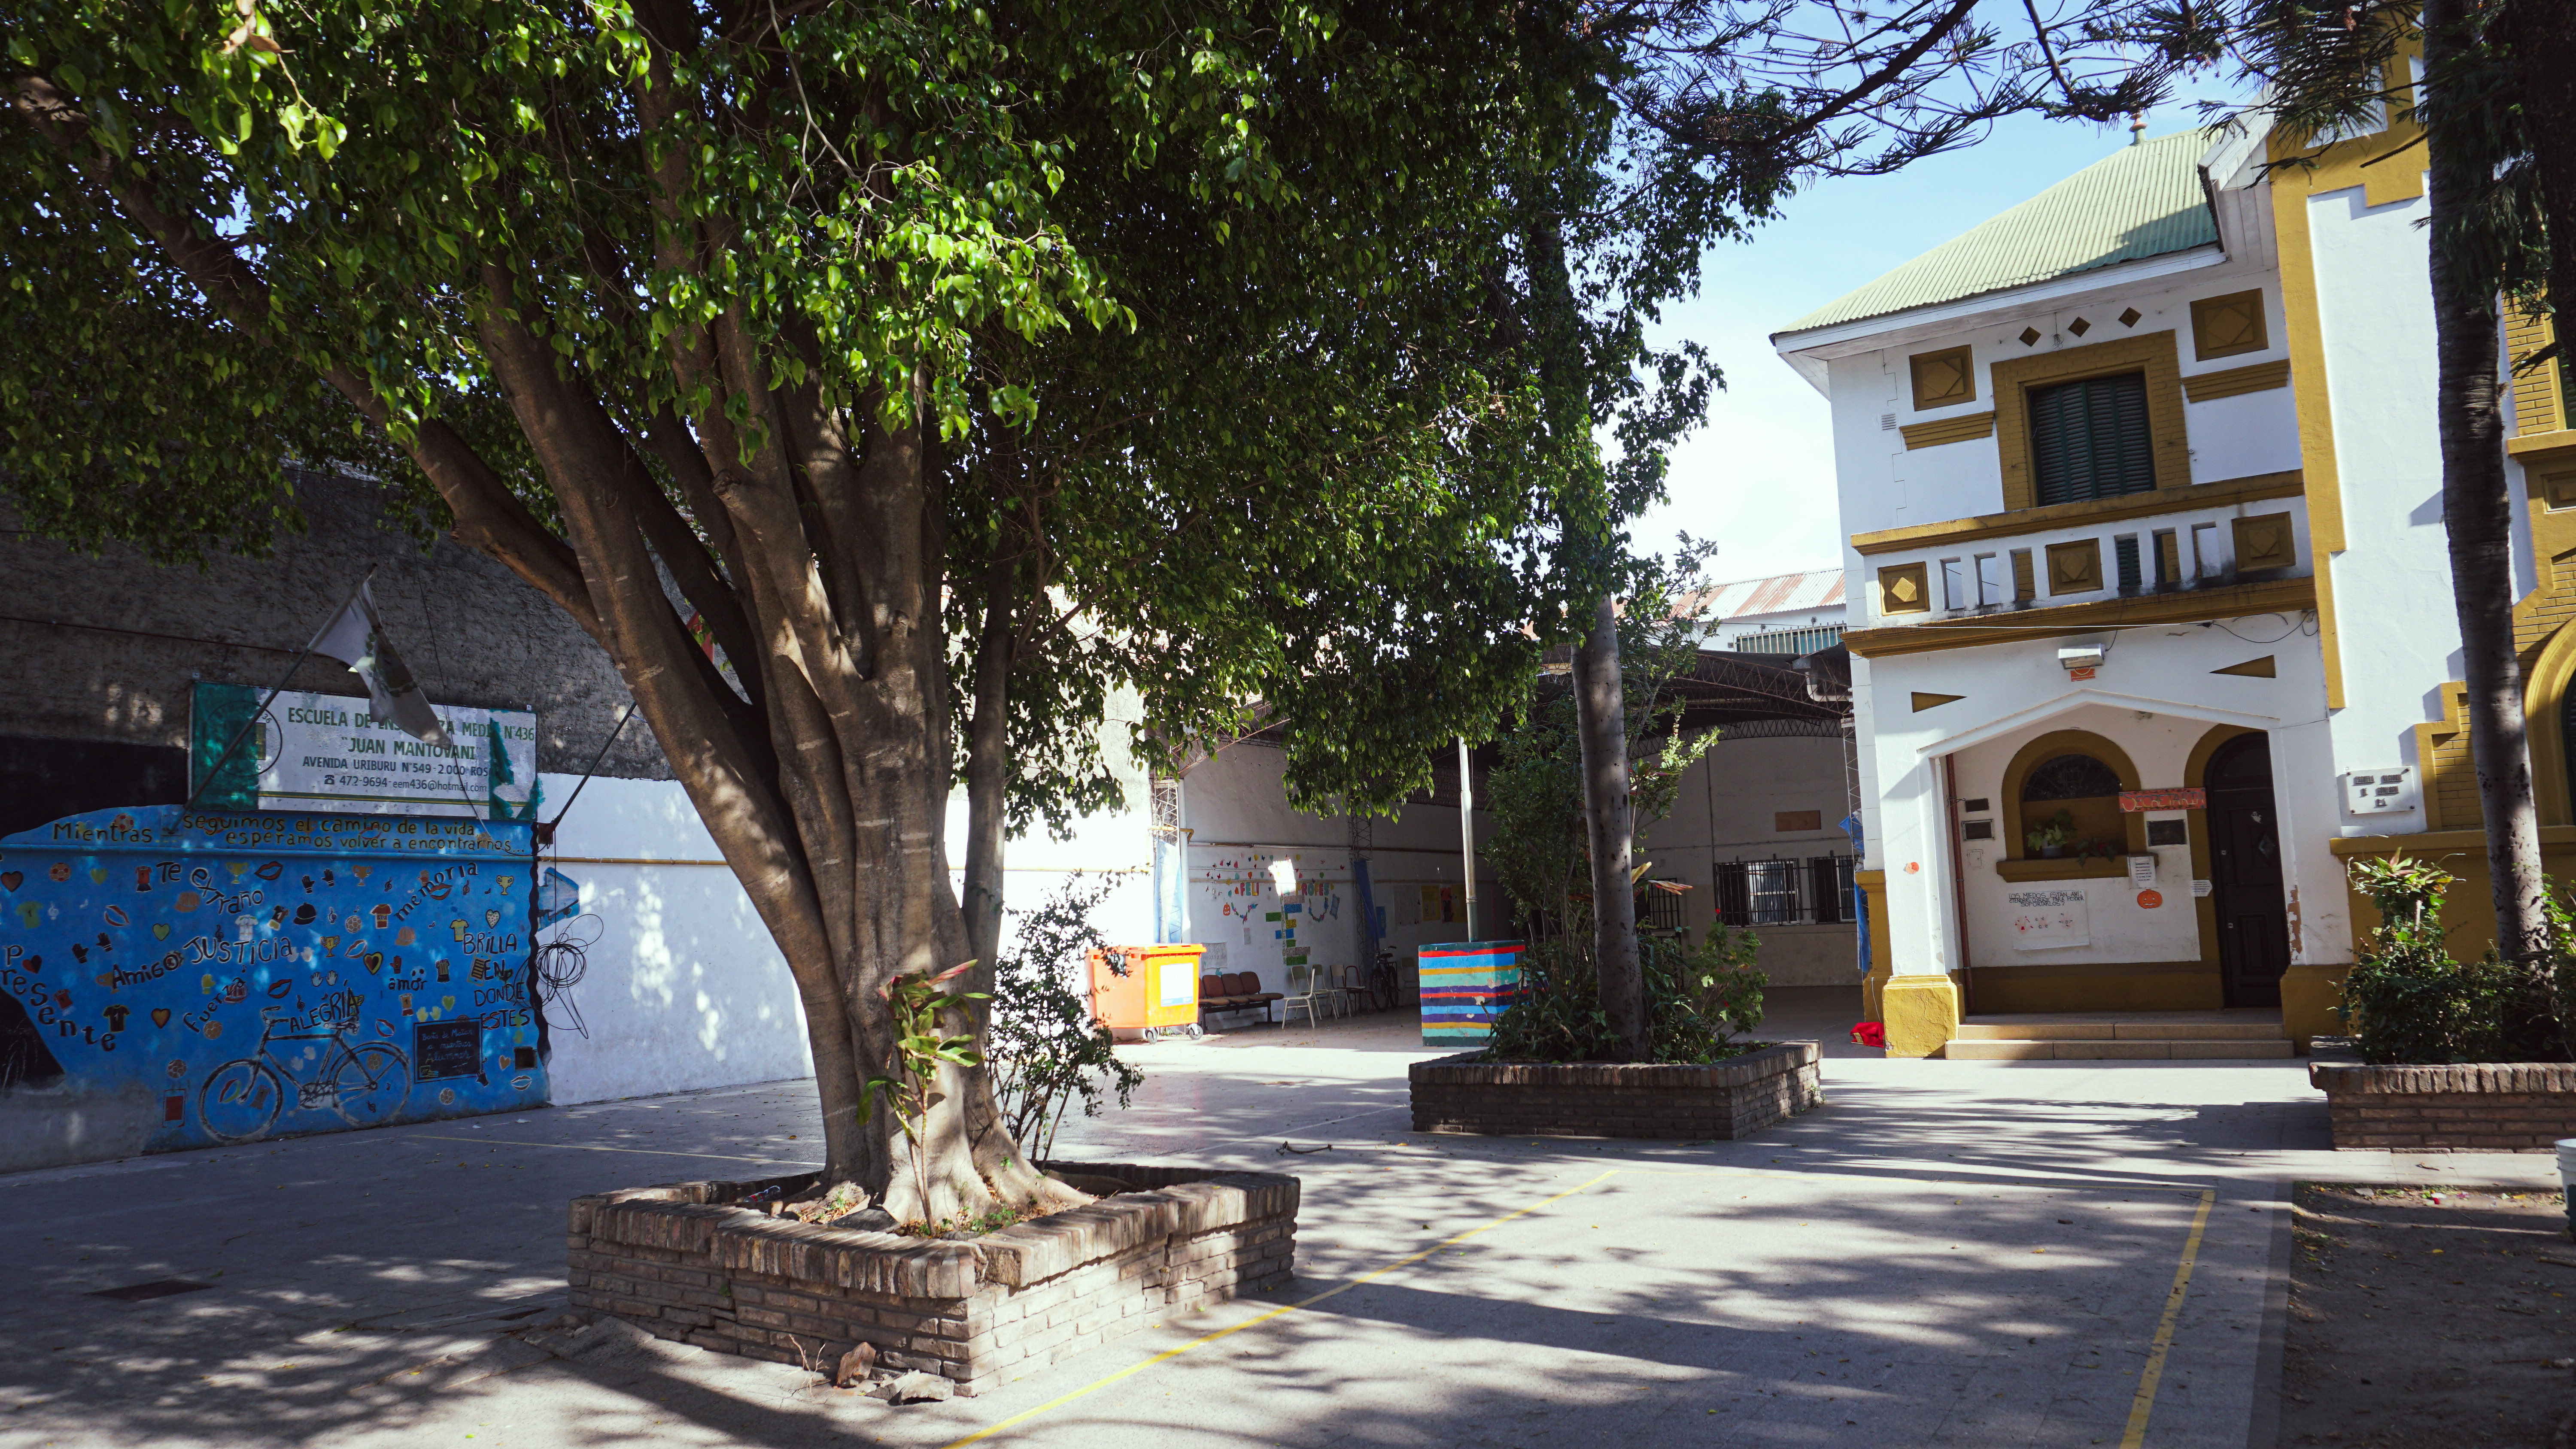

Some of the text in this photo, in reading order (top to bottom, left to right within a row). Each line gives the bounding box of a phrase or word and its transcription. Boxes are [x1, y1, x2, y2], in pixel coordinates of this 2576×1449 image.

[288, 706, 348, 727] ESCUELA
[355, 712, 371, 728] DE
[302, 756, 348, 769] AVENIDA
[353, 759, 396, 772] URIBURU
[53, 822, 153, 843] Mientras
[182, 814, 286, 836] seguimos
[295, 816, 310, 832] el
[320, 817, 391, 832] camino
[398, 819, 417, 834] de
[425, 821, 438, 835] la
[225, 831, 332, 848] esperamos
[340, 834, 386, 849] volver
[393, 838, 401, 849] a
[156, 861, 182, 883] Te
[393, 862, 479, 922] memoria
[484, 959, 505, 980] EN
[388, 977, 428, 991] amor
[474, 982, 526, 1007] DONDE
